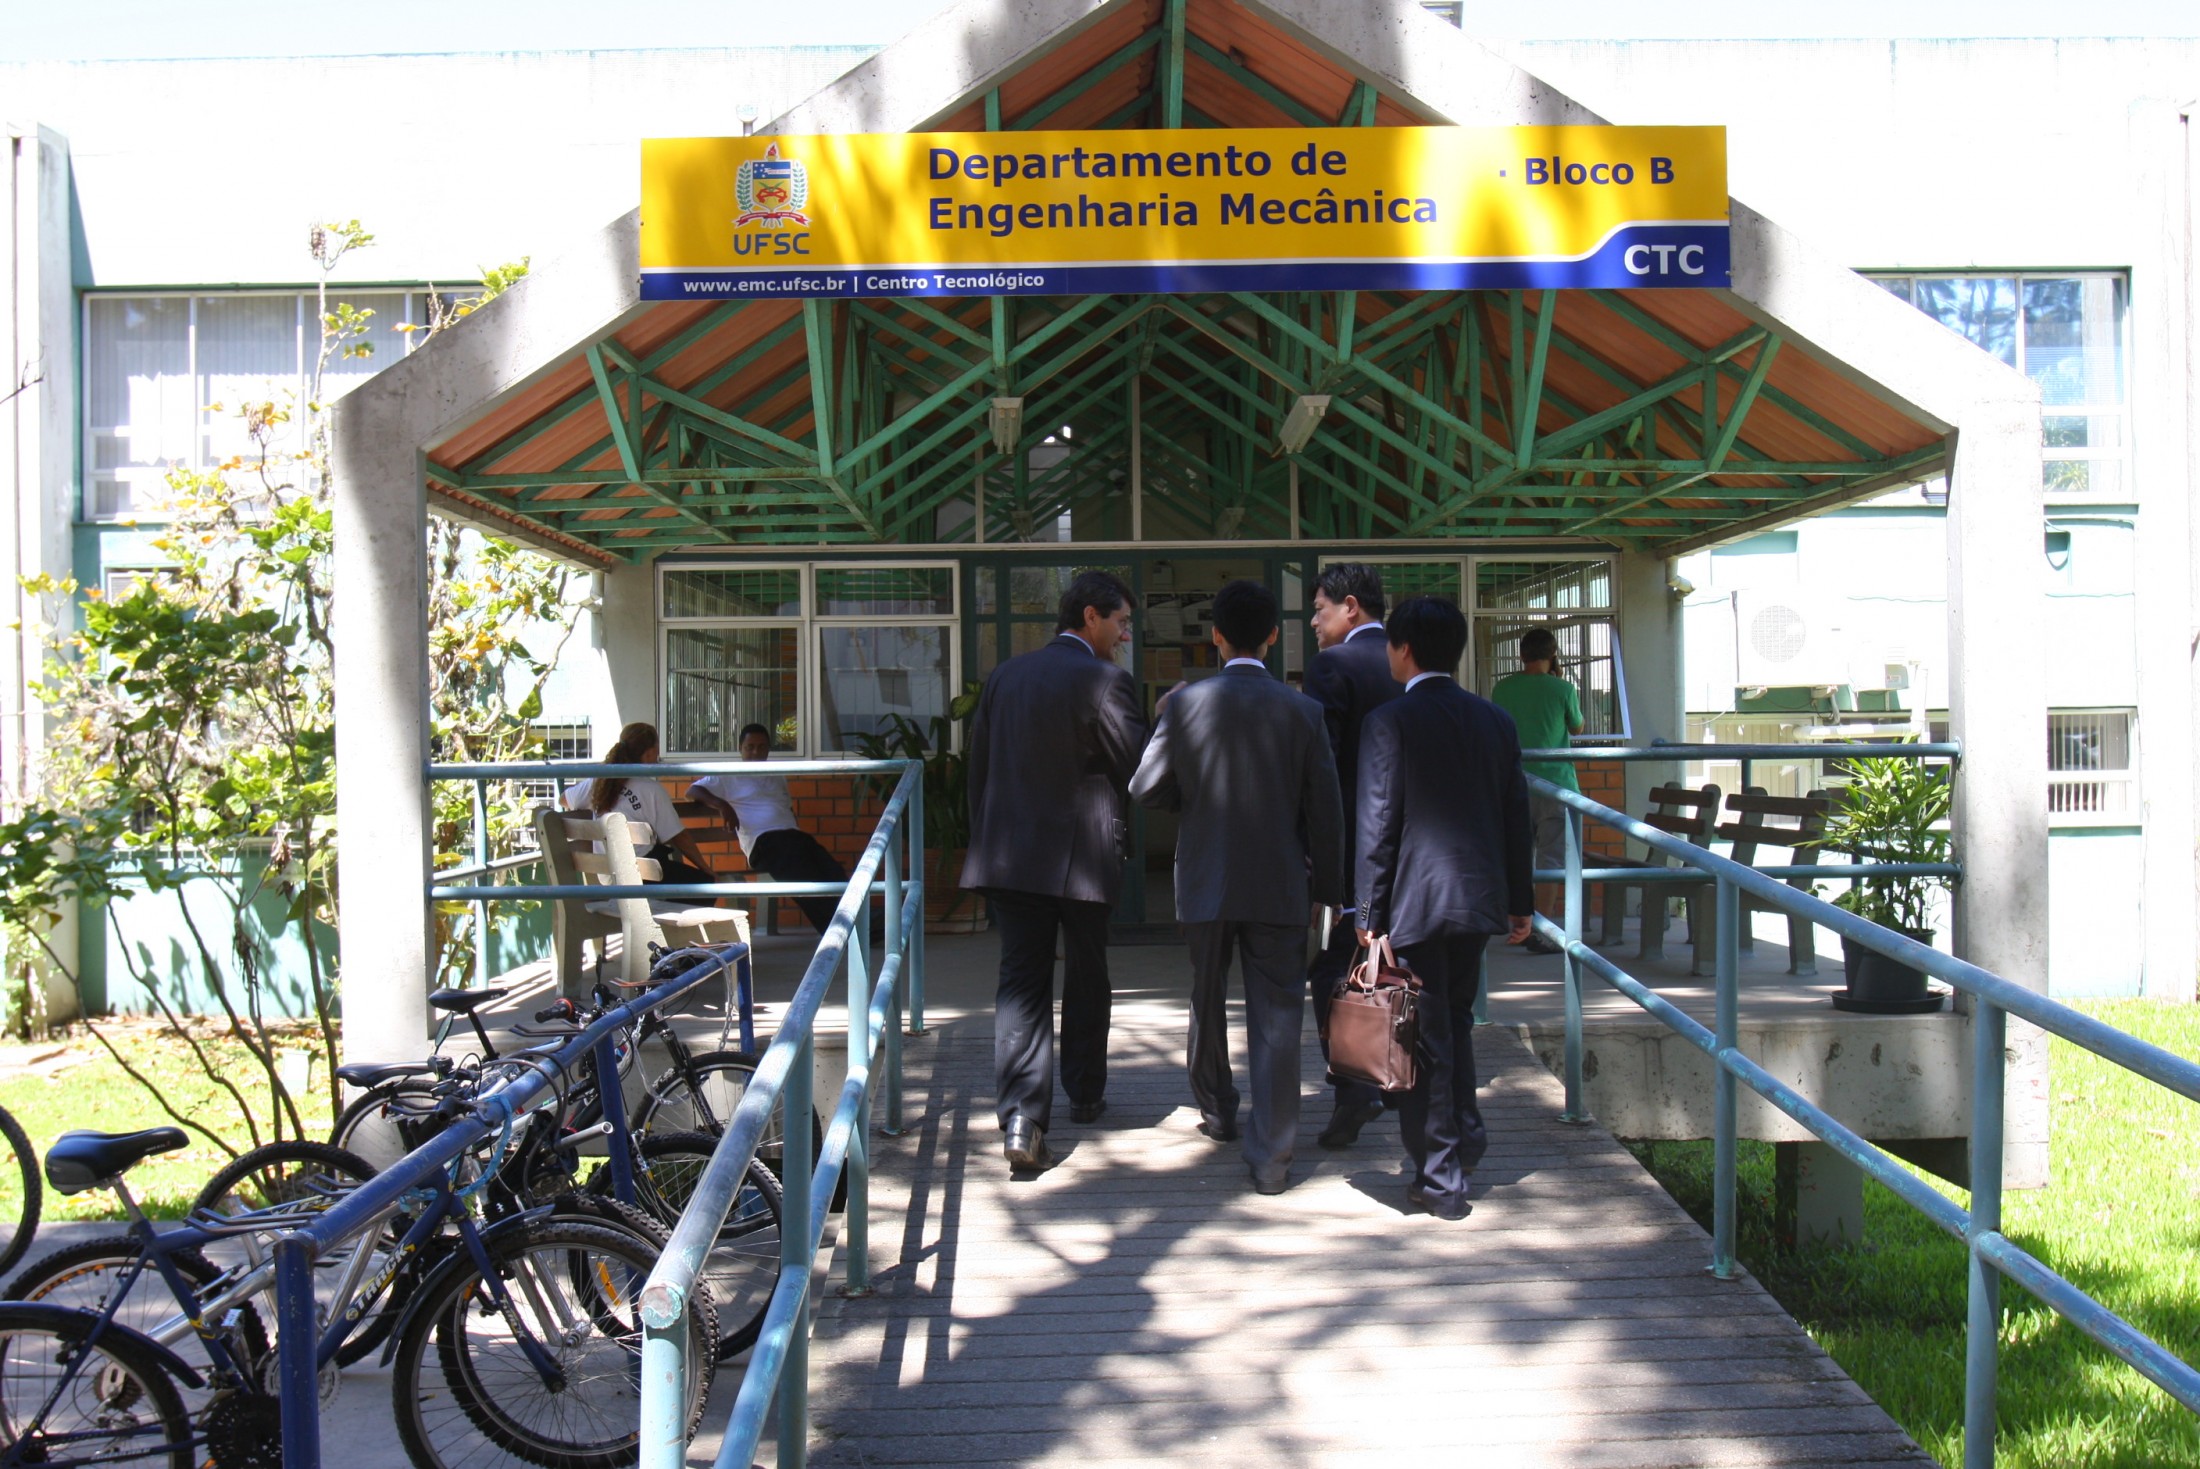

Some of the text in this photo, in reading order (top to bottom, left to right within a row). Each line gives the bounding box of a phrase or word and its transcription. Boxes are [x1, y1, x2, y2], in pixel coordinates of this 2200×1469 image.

[929, 143, 1347, 187] Departamento de
[1525, 156, 1675, 185] Bloco B
[929, 188, 1437, 237] Engenharia Mecânica
[733, 233, 810, 255] UFSC
[1624, 244, 1704, 275] CTC
[683, 276, 846, 292] www.emc.ufsc.br
[866, 275, 928, 291] Centro
[933, 273, 1045, 291] Tecnológico
[354, 1243, 408, 1310] TRACK
